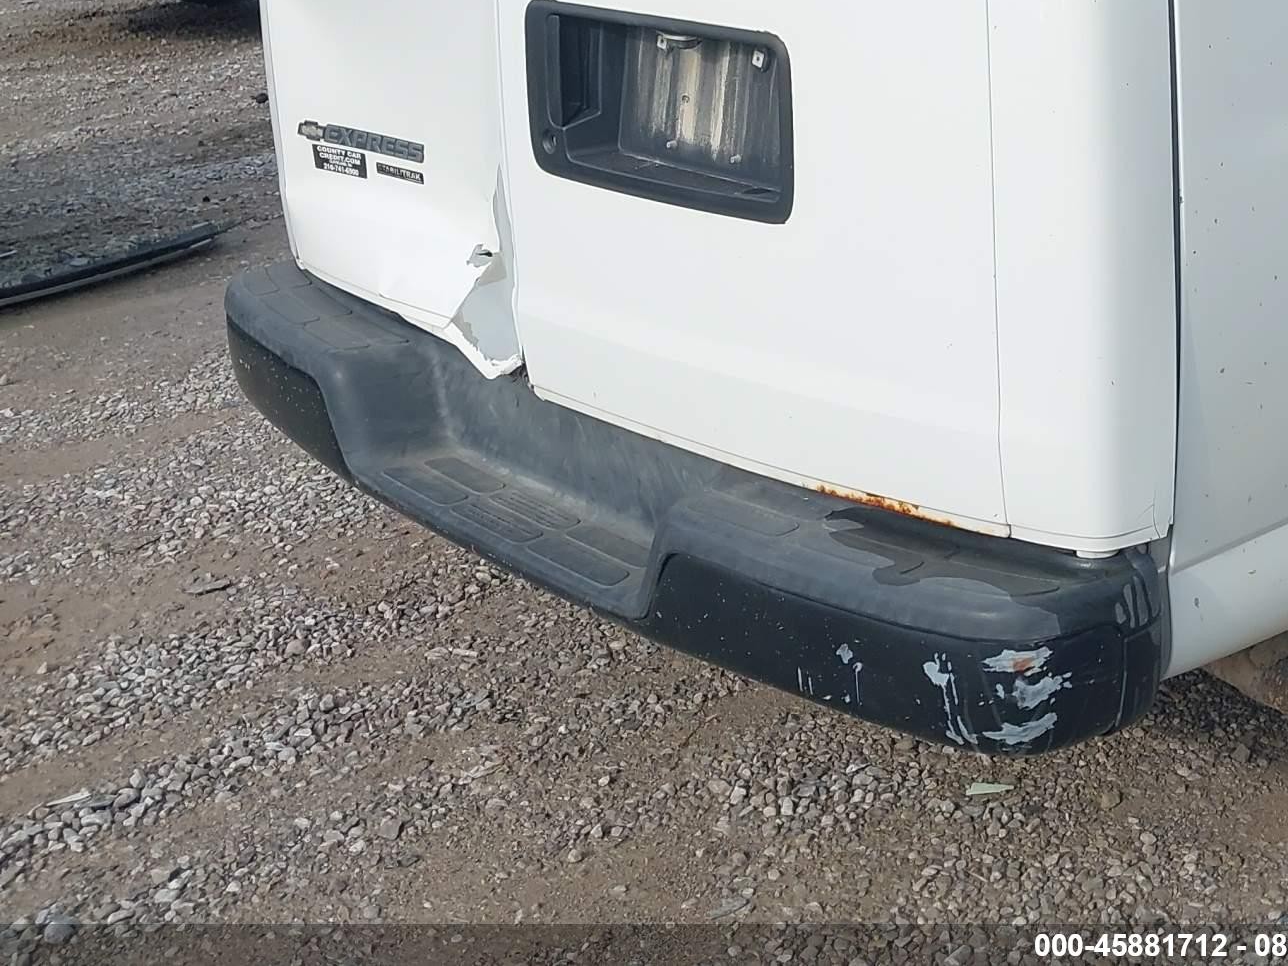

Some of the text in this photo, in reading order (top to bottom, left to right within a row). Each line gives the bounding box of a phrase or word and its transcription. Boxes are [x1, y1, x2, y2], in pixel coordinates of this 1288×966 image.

[317, 145, 361, 160] COUNTY CAR
[324, 125, 423, 162] EXPRESS
